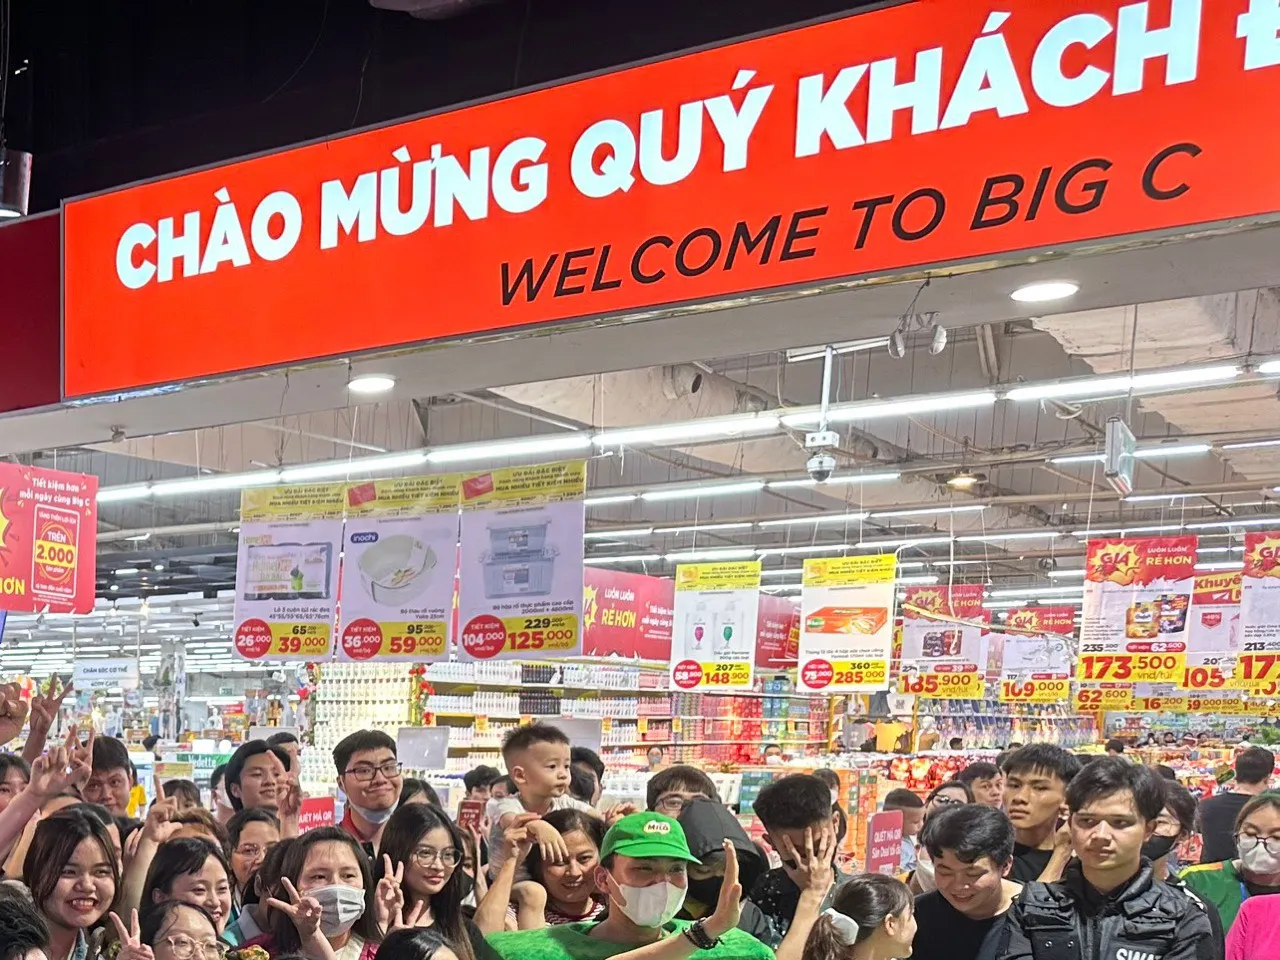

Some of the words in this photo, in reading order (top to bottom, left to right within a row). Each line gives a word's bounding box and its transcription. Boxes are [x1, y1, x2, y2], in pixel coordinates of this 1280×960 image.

[115, 186, 303, 290] CHÀO
[320, 136, 549, 250] MỪNG
[570, 68, 776, 198] QUÝ
[794, 0, 1202, 158] KHÁCH
[499, 206, 828, 306] WELCOME
[851, 187, 946, 251] TO
[969, 157, 1114, 232] BIG
[1141, 141, 1204, 201] C
[47, 530, 67, 543] TRÊN
[353, 532, 377, 542] inochi
[36, 544, 75, 565] 2.000
[1100, 551, 1132, 567] GIÁ
[1164, 555, 1193, 565] HƠN
[614, 609, 637, 629] HƠN
[237, 634, 272, 648] 26.000
[277, 636, 326, 654] 39.000
[343, 635, 381, 649] 36.000
[389, 635, 443, 654] 59.000
[462, 631, 505, 647] 104.000
[506, 629, 574, 651] 125.000
[82, 666, 98, 674] CHĂM
[1081, 655, 1177, 680] 173.500
[704, 672, 750, 685] 148.900
[834, 670, 885, 684] 285.000
[188, 753, 217, 769] Vedette
